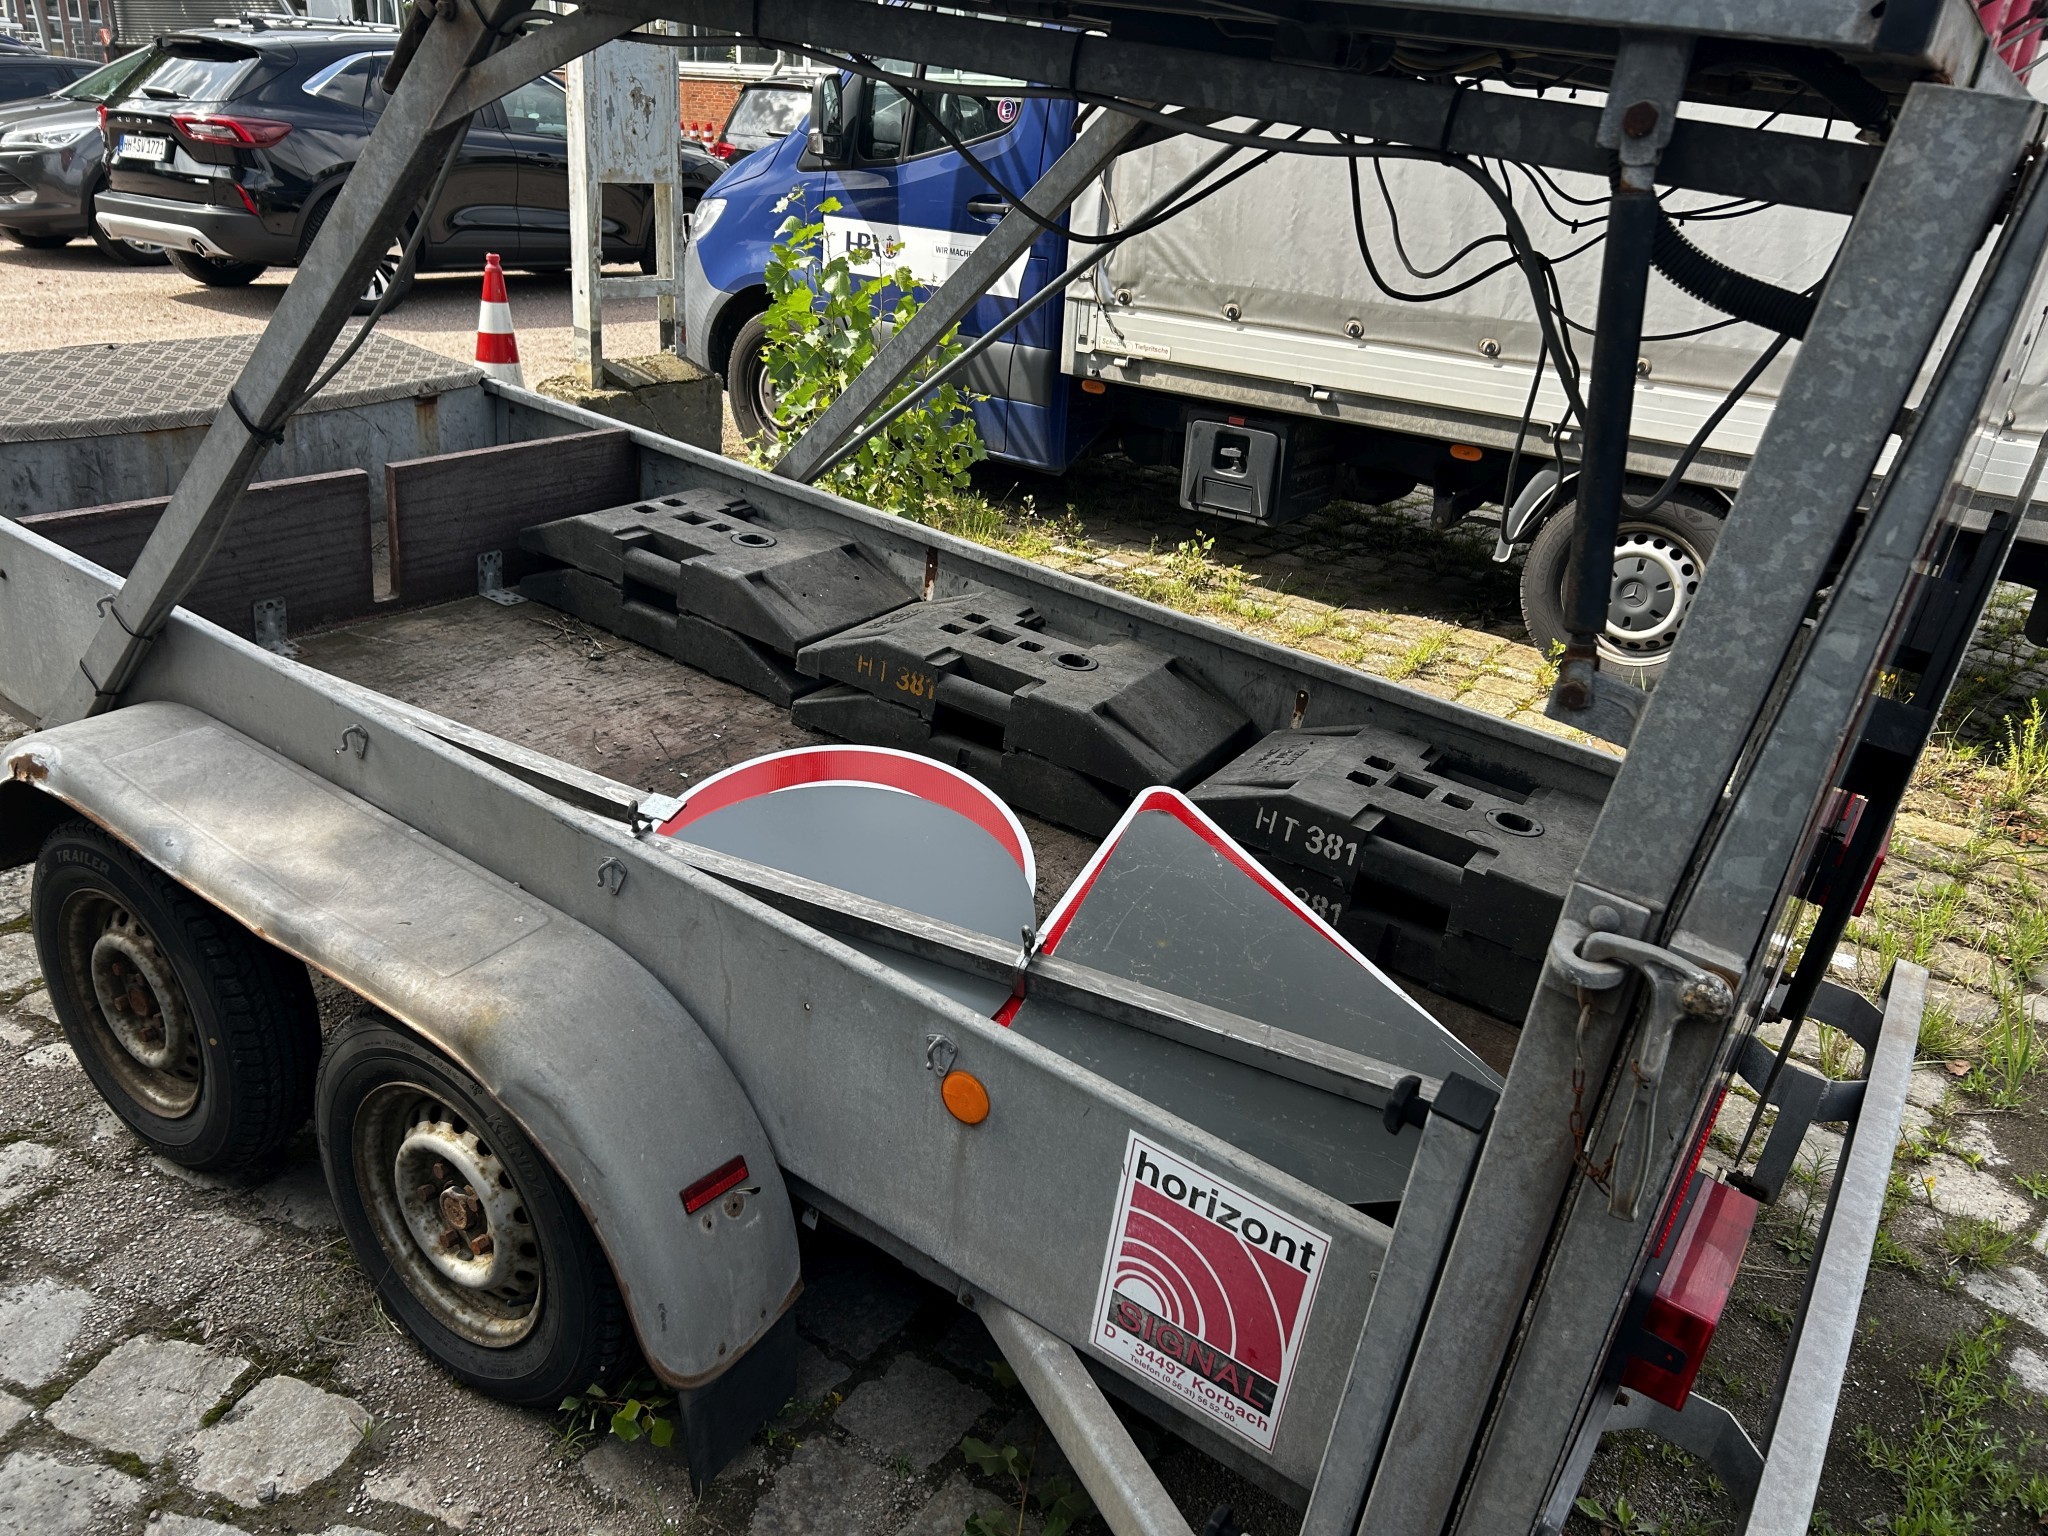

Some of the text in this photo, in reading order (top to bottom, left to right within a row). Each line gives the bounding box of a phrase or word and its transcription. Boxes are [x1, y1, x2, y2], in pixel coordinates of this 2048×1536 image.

[935, 246, 948, 254] WIR
[56, 849, 110, 877] TRAILER
[1305, 825, 1358, 866] 381
[485, 1113, 547, 1199] KENDA
[1135, 1150, 1316, 1273] horizont
[1104, 1324, 1116, 1338] D
[1135, 1343, 1186, 1379] 34497
[1192, 1376, 1268, 1432] Korbach
[1117, 1301, 1263, 1409] SIGNAL
[1130, 1354, 1160, 1377] Telefon
[1197, 1395, 1208, 1406] 56
